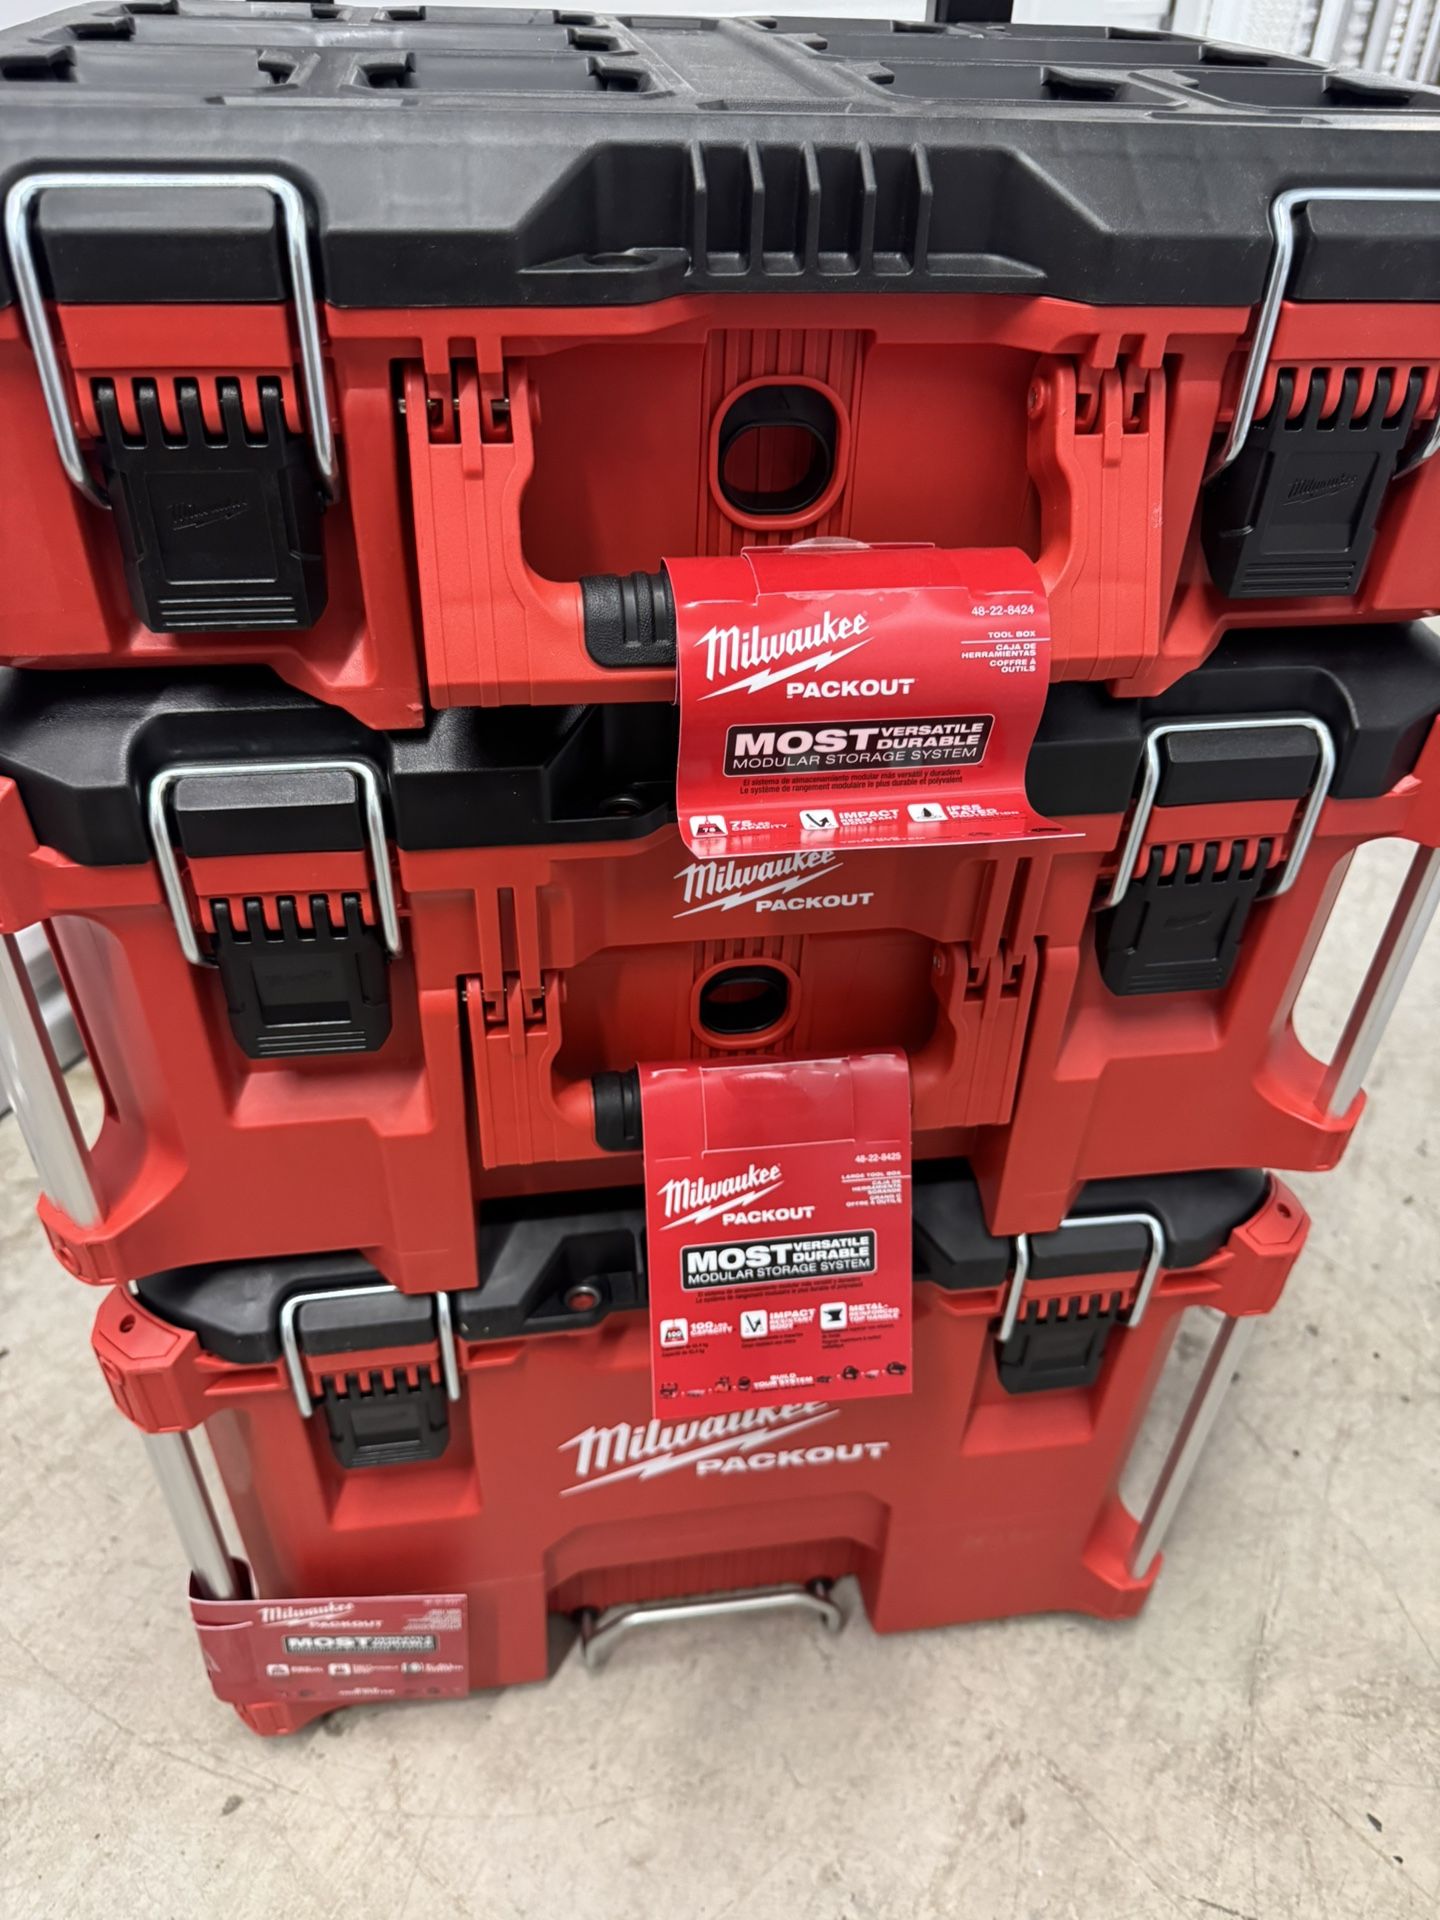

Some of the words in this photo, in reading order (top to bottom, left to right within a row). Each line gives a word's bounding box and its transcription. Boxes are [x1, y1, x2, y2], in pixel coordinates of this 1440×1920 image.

[971, 605, 1034, 616] 48-22-8424
[988, 631, 1014, 639] TOOL
[693, 611, 870, 681] Milwaukee
[995, 643, 1021, 651] CAJA
[961, 650, 1036, 659] HERRAMIENTAS
[989, 659, 1027, 667] COFFRE
[1001, 665, 1036, 673] OUTILS
[786, 678, 915, 700] PACKOUT
[881, 722, 985, 738] VERSATILE
[734, 728, 880, 757] MOST
[876, 734, 981, 750] DURABLE
[732, 754, 821, 769] MODULAR
[825, 750, 906, 765] STORAGE
[910, 747, 977, 760] SYSTEM
[838, 809, 899, 820] IMPACT
[673, 850, 836, 903] Milwaukee
[755, 892, 874, 913] PACKOUT
[656, 1163, 782, 1218] Milwaukee
[722, 1205, 816, 1226] PACKOUT
[792, 1236, 870, 1252] VERSATILE
[686, 1243, 794, 1274] MOST
[792, 1246, 870, 1263] DURABLE
[687, 1268, 754, 1286] MODULAR
[756, 1262, 817, 1278] STORAGE
[820, 1258, 871, 1272] SYSTEM
[769, 1308, 816, 1320] IMPACT
[696, 1441, 890, 1477] PACKOUT
[286, 1635, 370, 1649] MOST
